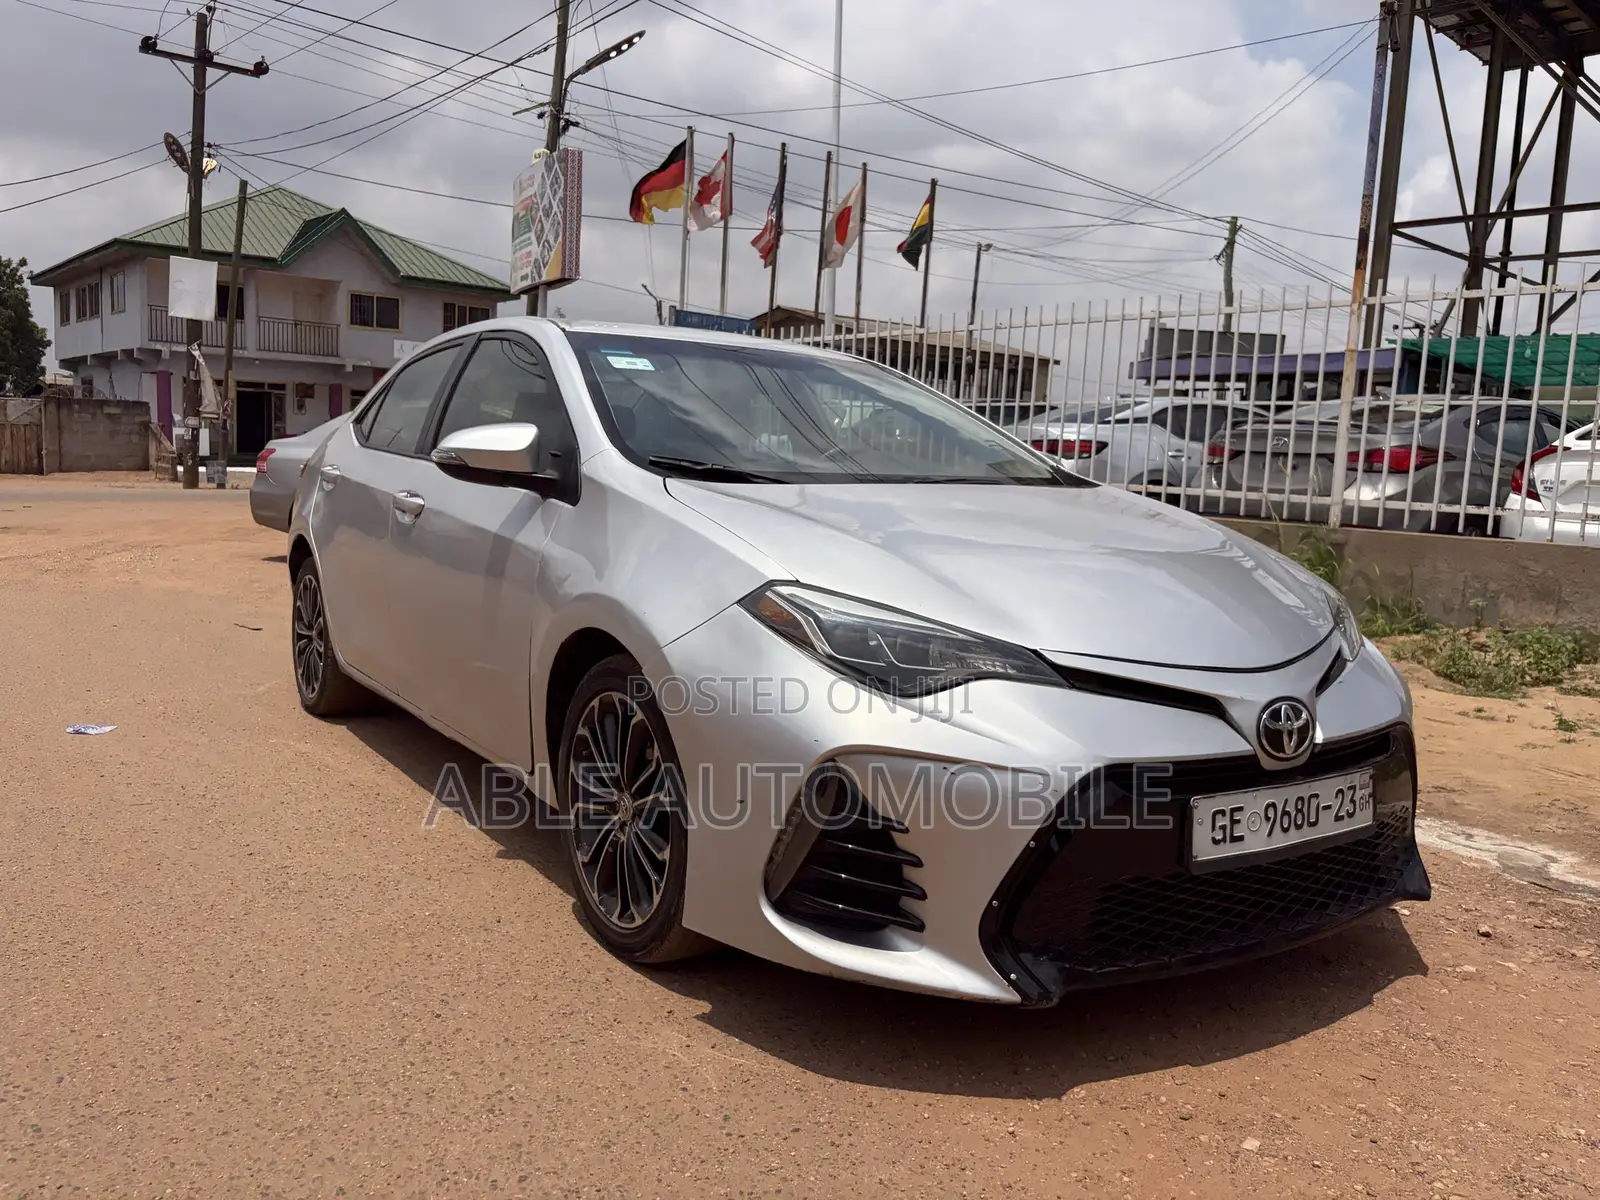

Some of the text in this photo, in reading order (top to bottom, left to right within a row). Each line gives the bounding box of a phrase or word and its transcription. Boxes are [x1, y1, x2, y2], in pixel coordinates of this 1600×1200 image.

[1211, 784, 1357, 846] GE 9680-23
[1359, 795, 1370, 812] GH
